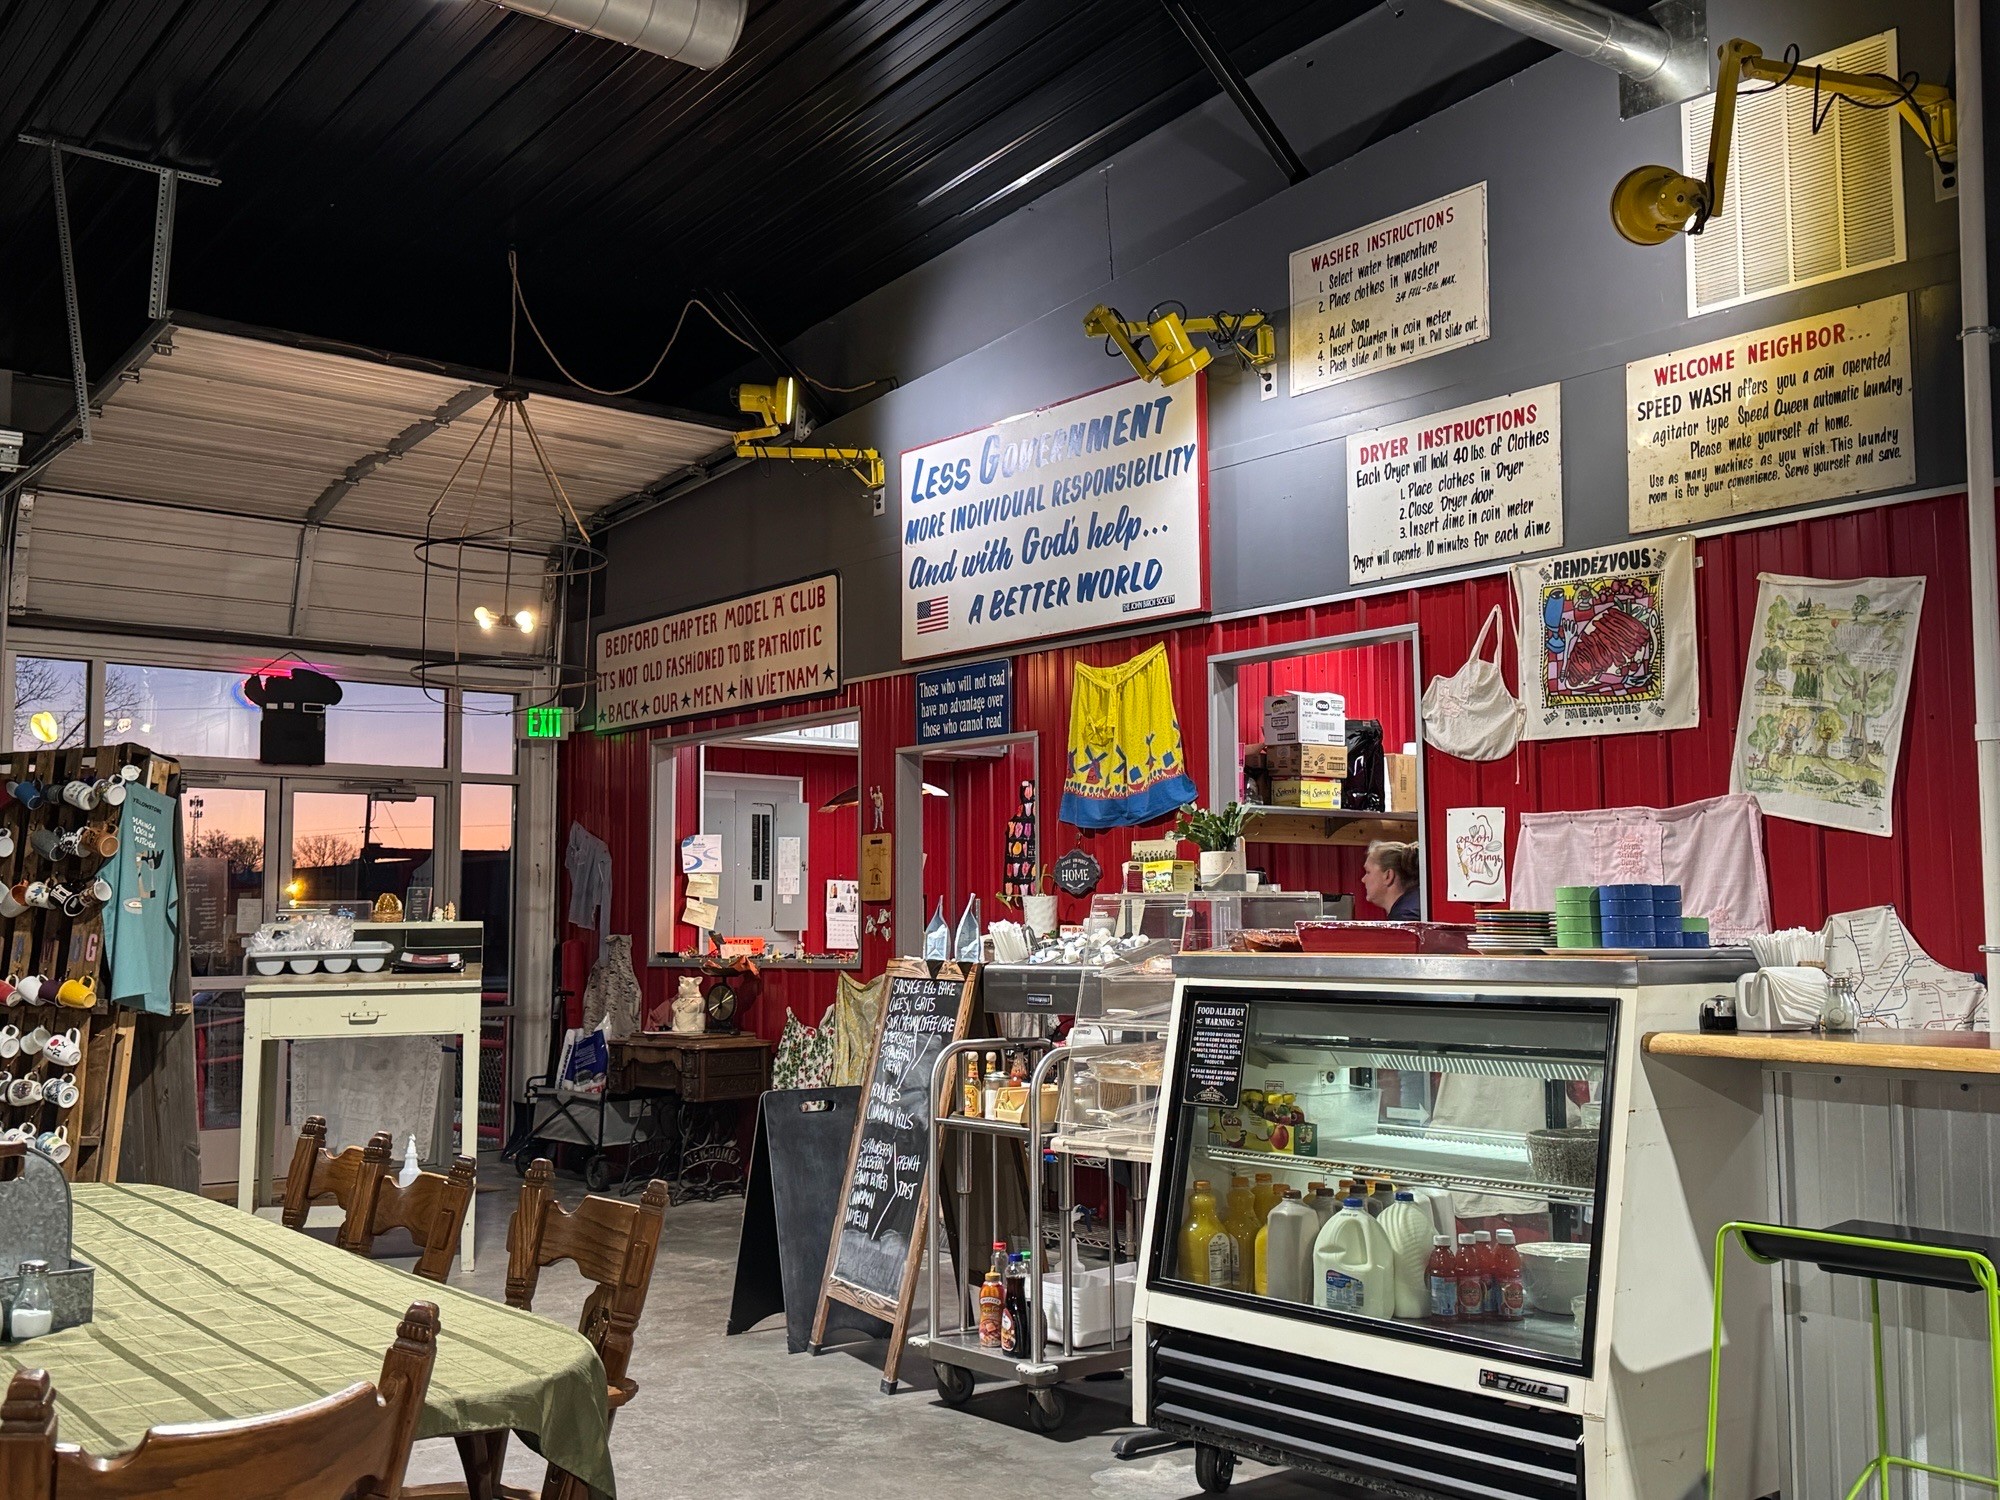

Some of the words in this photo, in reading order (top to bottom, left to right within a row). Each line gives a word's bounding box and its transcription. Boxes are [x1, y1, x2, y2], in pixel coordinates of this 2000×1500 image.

[1311, 242, 1359, 272] WASHER
[1367, 207, 1454, 253] INSTRUCTIONS
[1319, 280, 1323, 293] 1.
[1329, 269, 1353, 289] Select
[1358, 259, 1382, 278] water
[1386, 240, 1438, 273] temperature
[1319, 300, 1325, 313] 2.
[1329, 289, 1350, 310] Place
[1355, 278, 1385, 301] clothes
[1390, 274, 1398, 289] in
[1404, 260, 1440, 284] washer
[1317, 351, 1325, 361] 4.
[1330, 340, 1354, 358] Insert
[1358, 330, 1388, 348] Quarter
[1391, 325, 1398, 340] in
[1403, 320, 1421, 336] coin
[1426, 309, 1451, 328] meter
[1319, 333, 1325, 344] 3.
[1329, 326, 1345, 341] Add
[1351, 318, 1369, 334] Soap
[1638, 394, 1681, 421] SPEED
[1689, 382, 1731, 410] WASH
[1738, 377, 1768, 400] offers
[1777, 373, 1796, 395] you
[1803, 371, 1809, 383] a
[1814, 363, 1834, 381] coin
[1843, 347, 1891, 377] operated
[1654, 350, 1735, 387] WELCOME
[1653, 423, 1699, 447] agitator
[1706, 415, 1729, 436] type
[1738, 402, 1769, 427] Speed
[1774, 397, 1809, 417] Queen
[1813, 385, 1859, 408] automatic
[1864, 376, 1903, 399] laundry
[1360, 437, 1409, 465] DRYER
[1418, 404, 1537, 452] INSTRUCTIONS
[1690, 440, 1722, 459] Please
[1729, 431, 1752, 451] make
[1758, 422, 1802, 449] yourself
[1808, 418, 1819, 435] at
[1825, 413, 1852, 433] home.
[1357, 464, 1380, 488] Each
[1384, 462, 1410, 484] Dryer
[1414, 456, 1427, 476] will
[1431, 450, 1448, 470] hold
[1453, 447, 1468, 465] 40
[1471, 445, 1486, 461] lbs.
[1491, 437, 1502, 455] of
[1508, 429, 1549, 453] Clothes
[905, 511, 946, 545] MORE
[950, 484, 1046, 534] INDIVIDUAL
[1052, 443, 1196, 507] RESPONSIBILITY
[1409, 482, 1433, 499] Place
[1438, 472, 1475, 492] clothes
[1481, 468, 1490, 481] in
[1497, 460, 1524, 482] Dryer
[1399, 508, 1407, 520] 2.
[1408, 501, 1434, 519] Close
[1441, 495, 1467, 514] Dryer
[1471, 488, 1494, 505] door
[909, 549, 958, 590] And
[962, 537, 1014, 577] with
[1021, 516, 1079, 564] God's
[1087, 505, 1168, 550] help...
[1353, 554, 1374, 574] Dryer
[1377, 550, 1389, 566] will
[1393, 545, 1422, 565] operate
[1426, 540, 1434, 556] 10
[1437, 537, 1468, 554] minutes
[1474, 530, 1489, 547] for
[1495, 525, 1518, 543] each
[1525, 521, 1551, 538] dime
[1554, 548, 1651, 580] RENDEZVOUS
[968, 594, 984, 625] A
[989, 576, 1070, 622] BETTER
[1076, 558, 1163, 602] WORLD
[605, 627, 658, 658] BEDFORD
[663, 612, 718, 644] CHAPTER
[724, 599, 769, 630] MODEL
[790, 585, 826, 613] CLUB
[619, 666, 637, 688] NOT
[643, 660, 662, 683] OLD
[728, 644, 739, 664] TO
[743, 639, 755, 662] BE
[920, 683, 939, 698] Those
[941, 679, 956, 694] who
[958, 675, 971, 691] will
[975, 673, 986, 690] not
[989, 669, 1005, 687] read
[608, 699, 639, 724] BACK
[653, 692, 678, 715] OUR
[693, 683, 723, 707] MEN
[922, 703, 937, 718] have
[939, 703, 948, 715] no
[950, 696, 985, 712] advantage
[988, 695, 1003, 707] over
[1565, 704, 1641, 719] MEMPHIS
[528, 708, 563, 737] EXIT
[923, 722, 940, 737] those
[943, 719, 957, 734] who
[960, 715, 983, 732] cannot
[986, 712, 1002, 729] read
[1276, 787, 1297, 797] Splenda
[1313, 788, 1330, 798] Splenda
[1062, 869, 1089, 881] HOME
[915, 996, 935, 1012] GRITS
[923, 980, 937, 994] EGG
[938, 981, 956, 996] BAKE
[886, 1014, 899, 1031] SOUR
[918, 1015, 939, 1031] COFFEE
[937, 1016, 955, 1032] CAKE
[1205, 1018, 1234, 1026] WARNING
[1215, 1008, 1245, 1016] ALLERGY
[895, 1107, 914, 1130] ROLLS
[897, 1155, 920, 1172] FRENCH
[898, 1181, 917, 1200] TOAST
